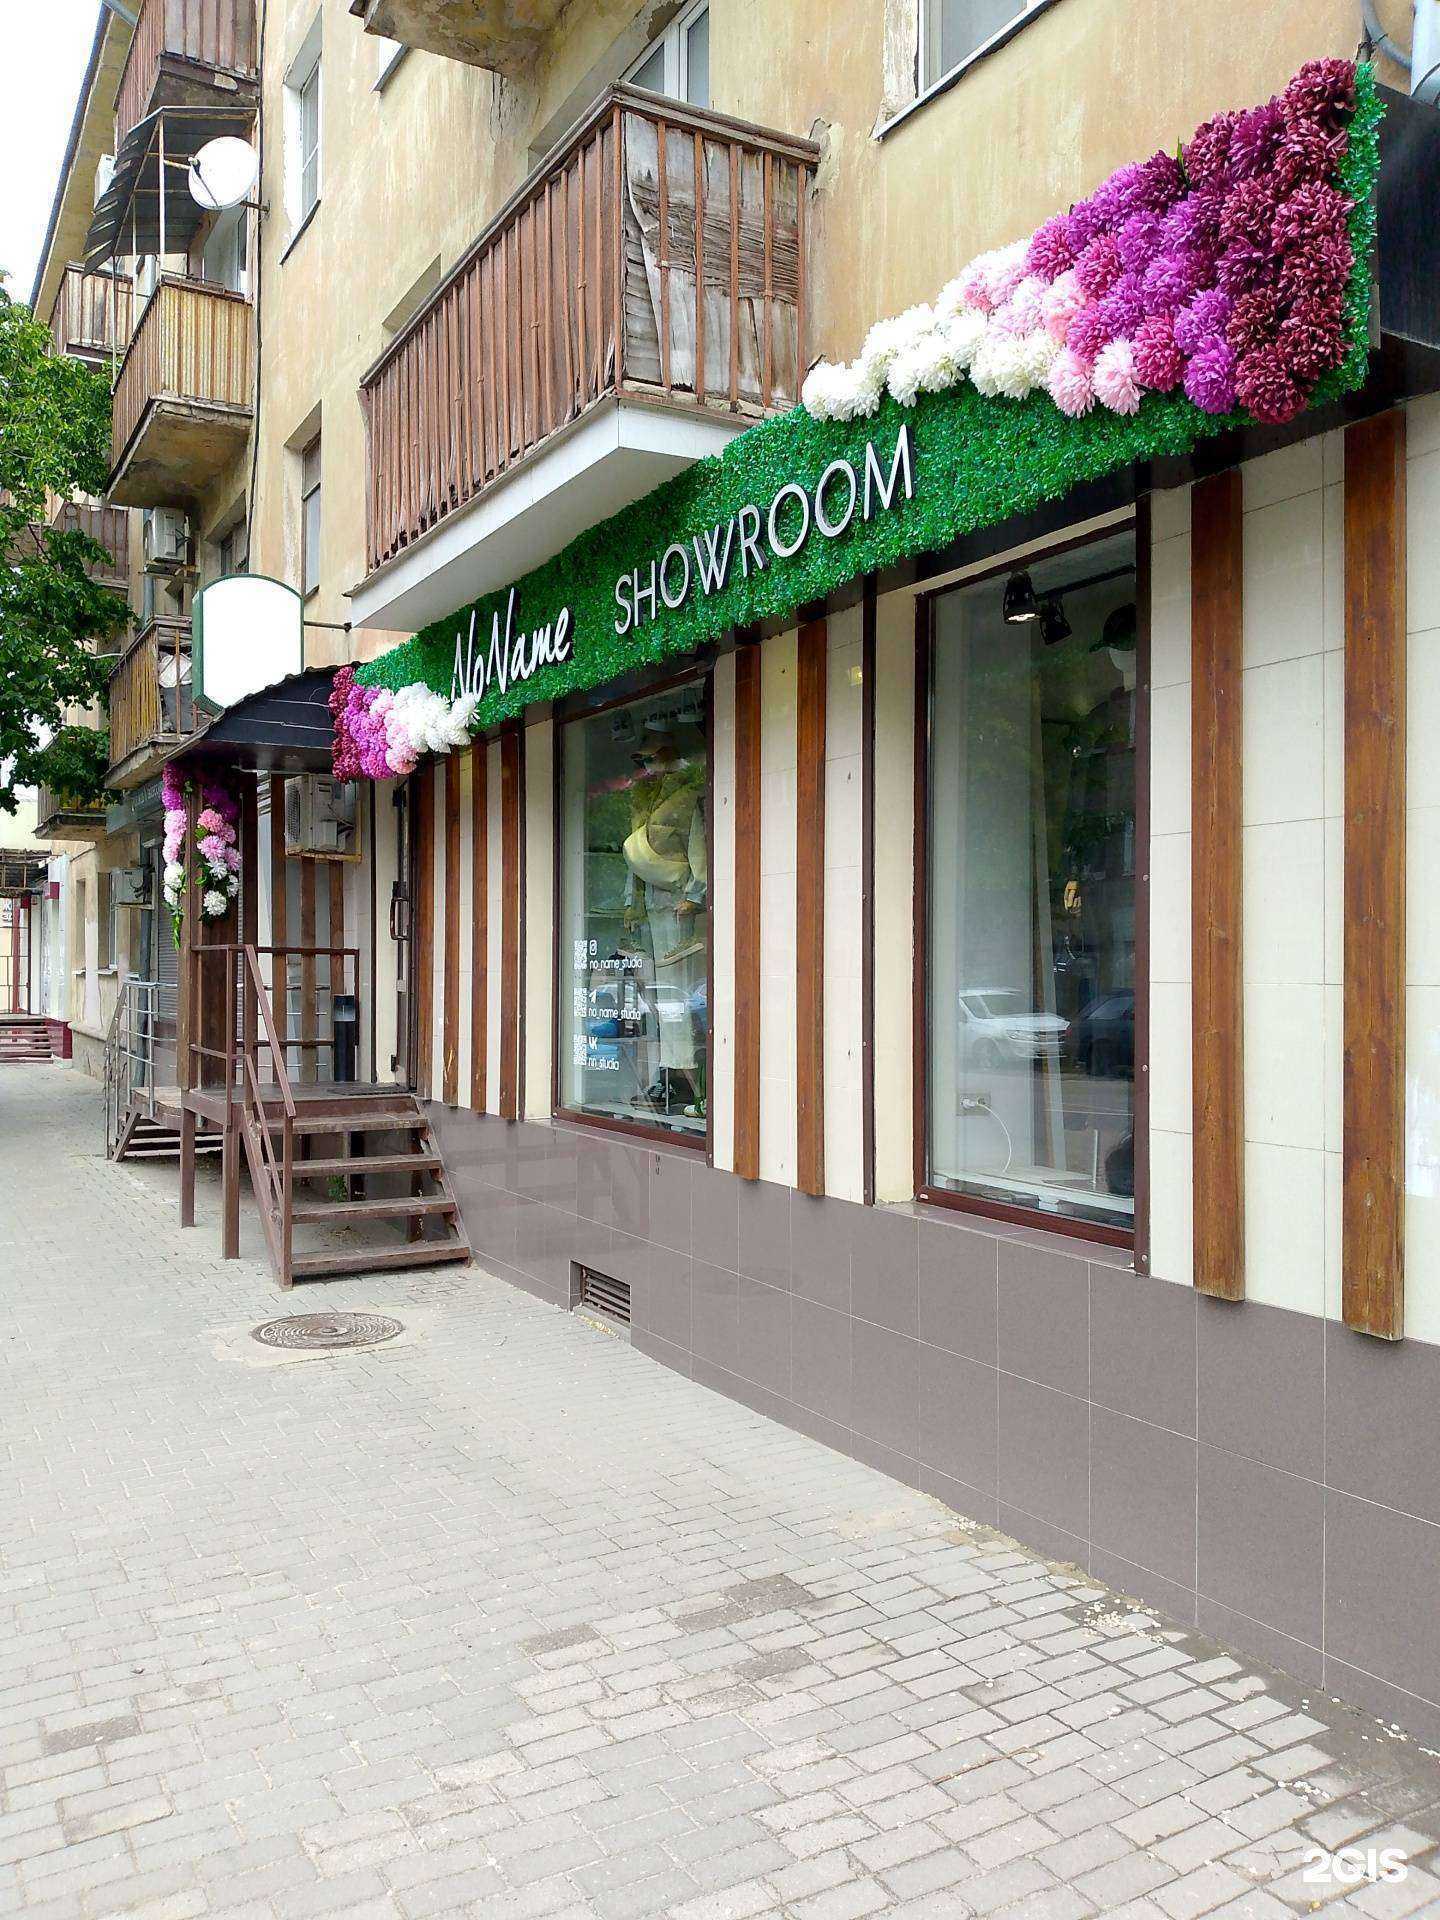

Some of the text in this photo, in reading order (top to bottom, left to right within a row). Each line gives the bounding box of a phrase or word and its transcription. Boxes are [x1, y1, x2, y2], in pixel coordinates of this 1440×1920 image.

[615, 424, 913, 635] SHOWROOM
[589, 955, 643, 971] no_name_studio
[588, 1007, 641, 1021] no_name_studio
